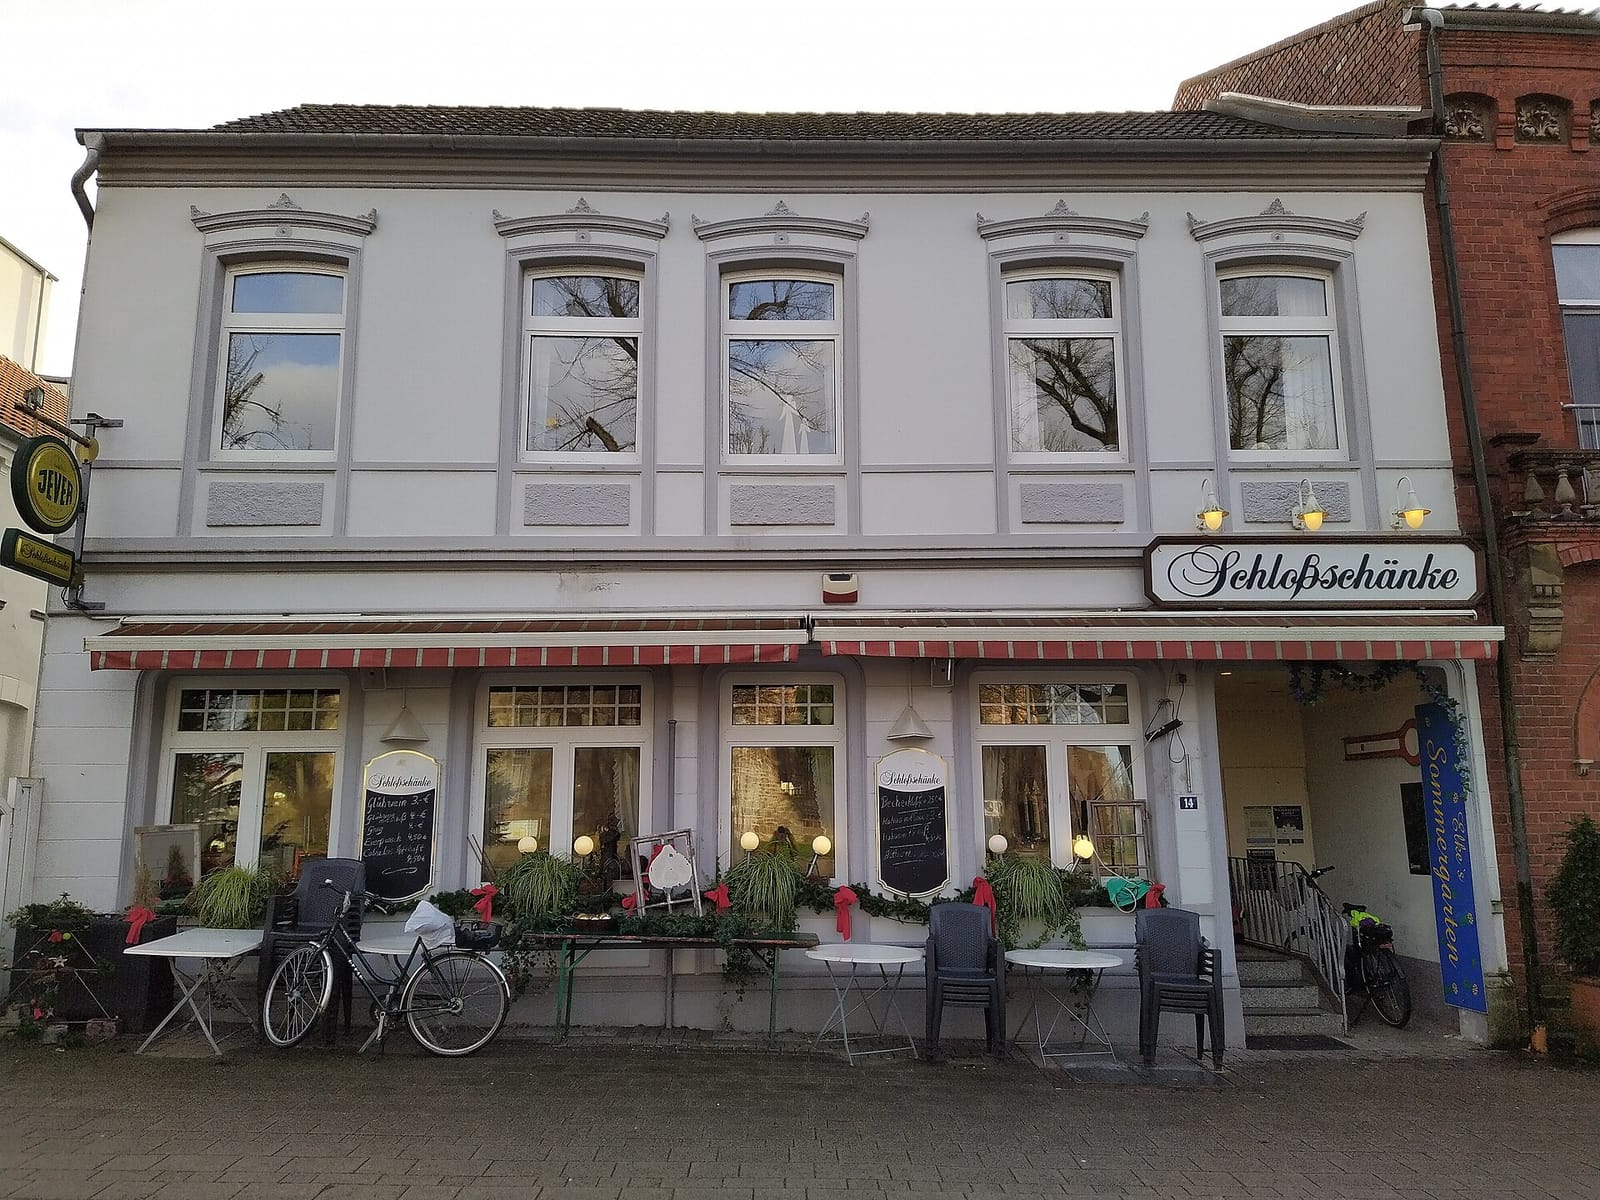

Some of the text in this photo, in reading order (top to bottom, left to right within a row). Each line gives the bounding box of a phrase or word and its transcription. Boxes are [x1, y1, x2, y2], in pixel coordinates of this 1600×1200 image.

[38, 469, 74, 506] JEVER
[21, 542, 70, 572] Schloßschänke
[1167, 544, 1460, 600] Schloßschänke
[368, 772, 432, 790] Schloßschänke
[880, 769, 941, 786] Schloßschänke
[1183, 798, 1194, 809] 14
[1425, 739, 1459, 970] Sommergarten
